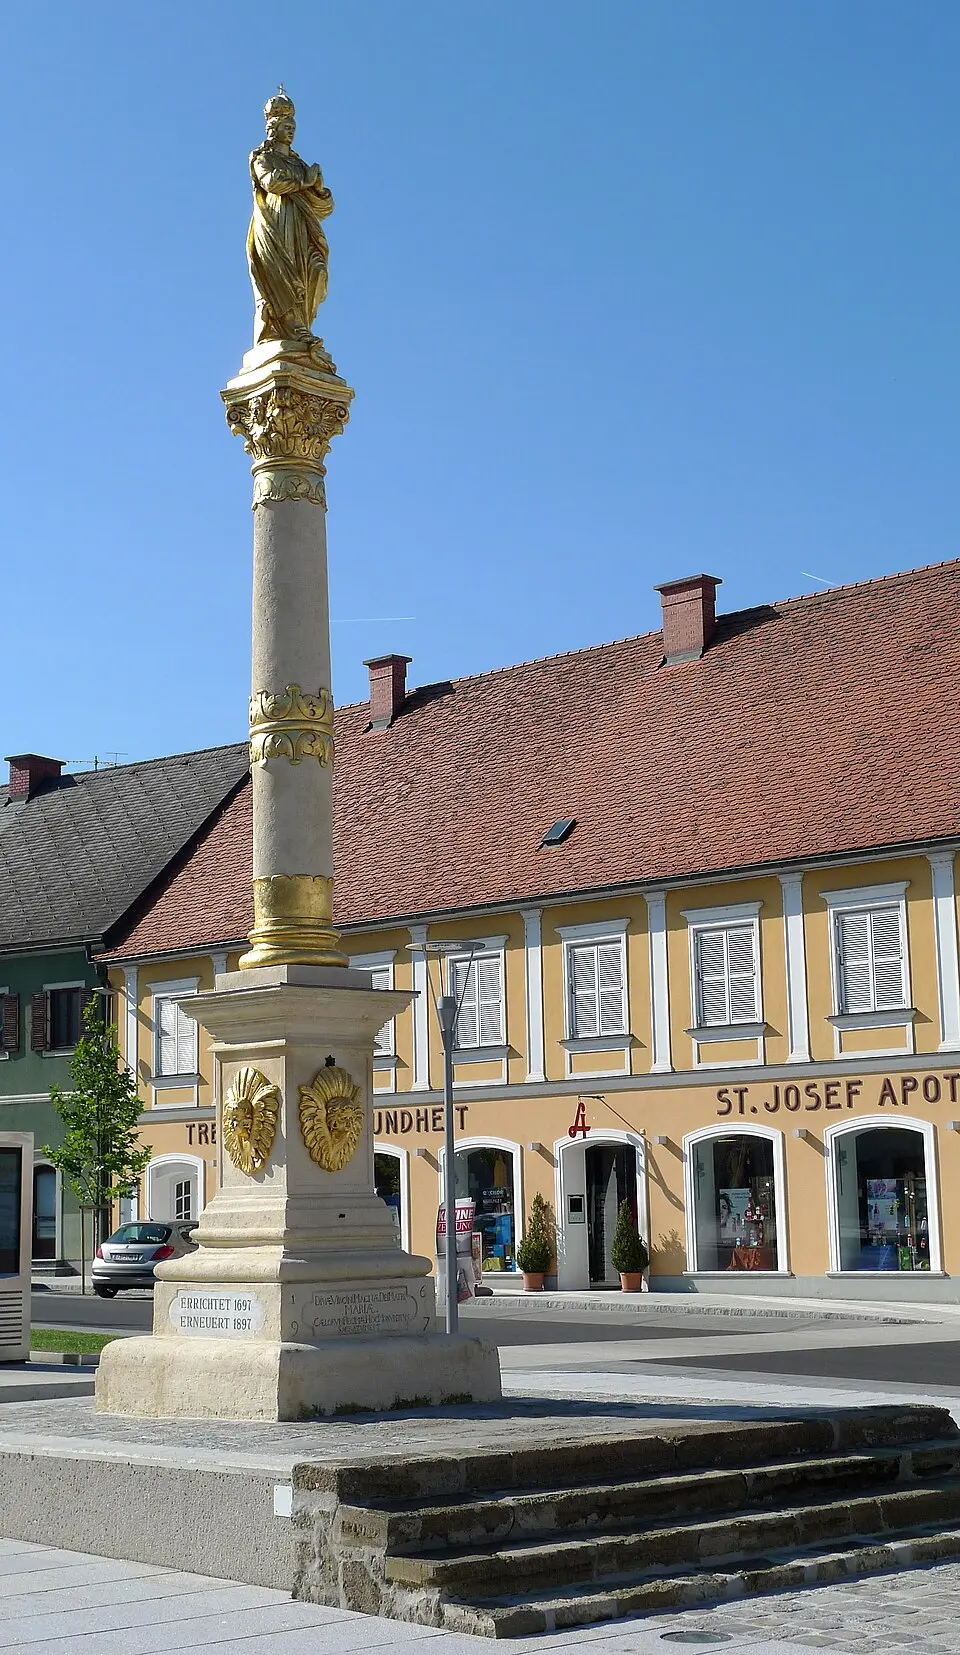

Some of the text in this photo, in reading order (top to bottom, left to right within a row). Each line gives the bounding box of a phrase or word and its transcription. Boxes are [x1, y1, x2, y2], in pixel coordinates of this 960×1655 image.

[374, 1105, 469, 1135] UNDHET
[419, 1285, 426, 1298] 6
[180, 1297, 252, 1311] ERRICHTET 1697
[180, 1315, 252, 1330] ERNEUERT 1897
[291, 1320, 299, 1336] 9
[422, 1316, 430, 1331] 7
